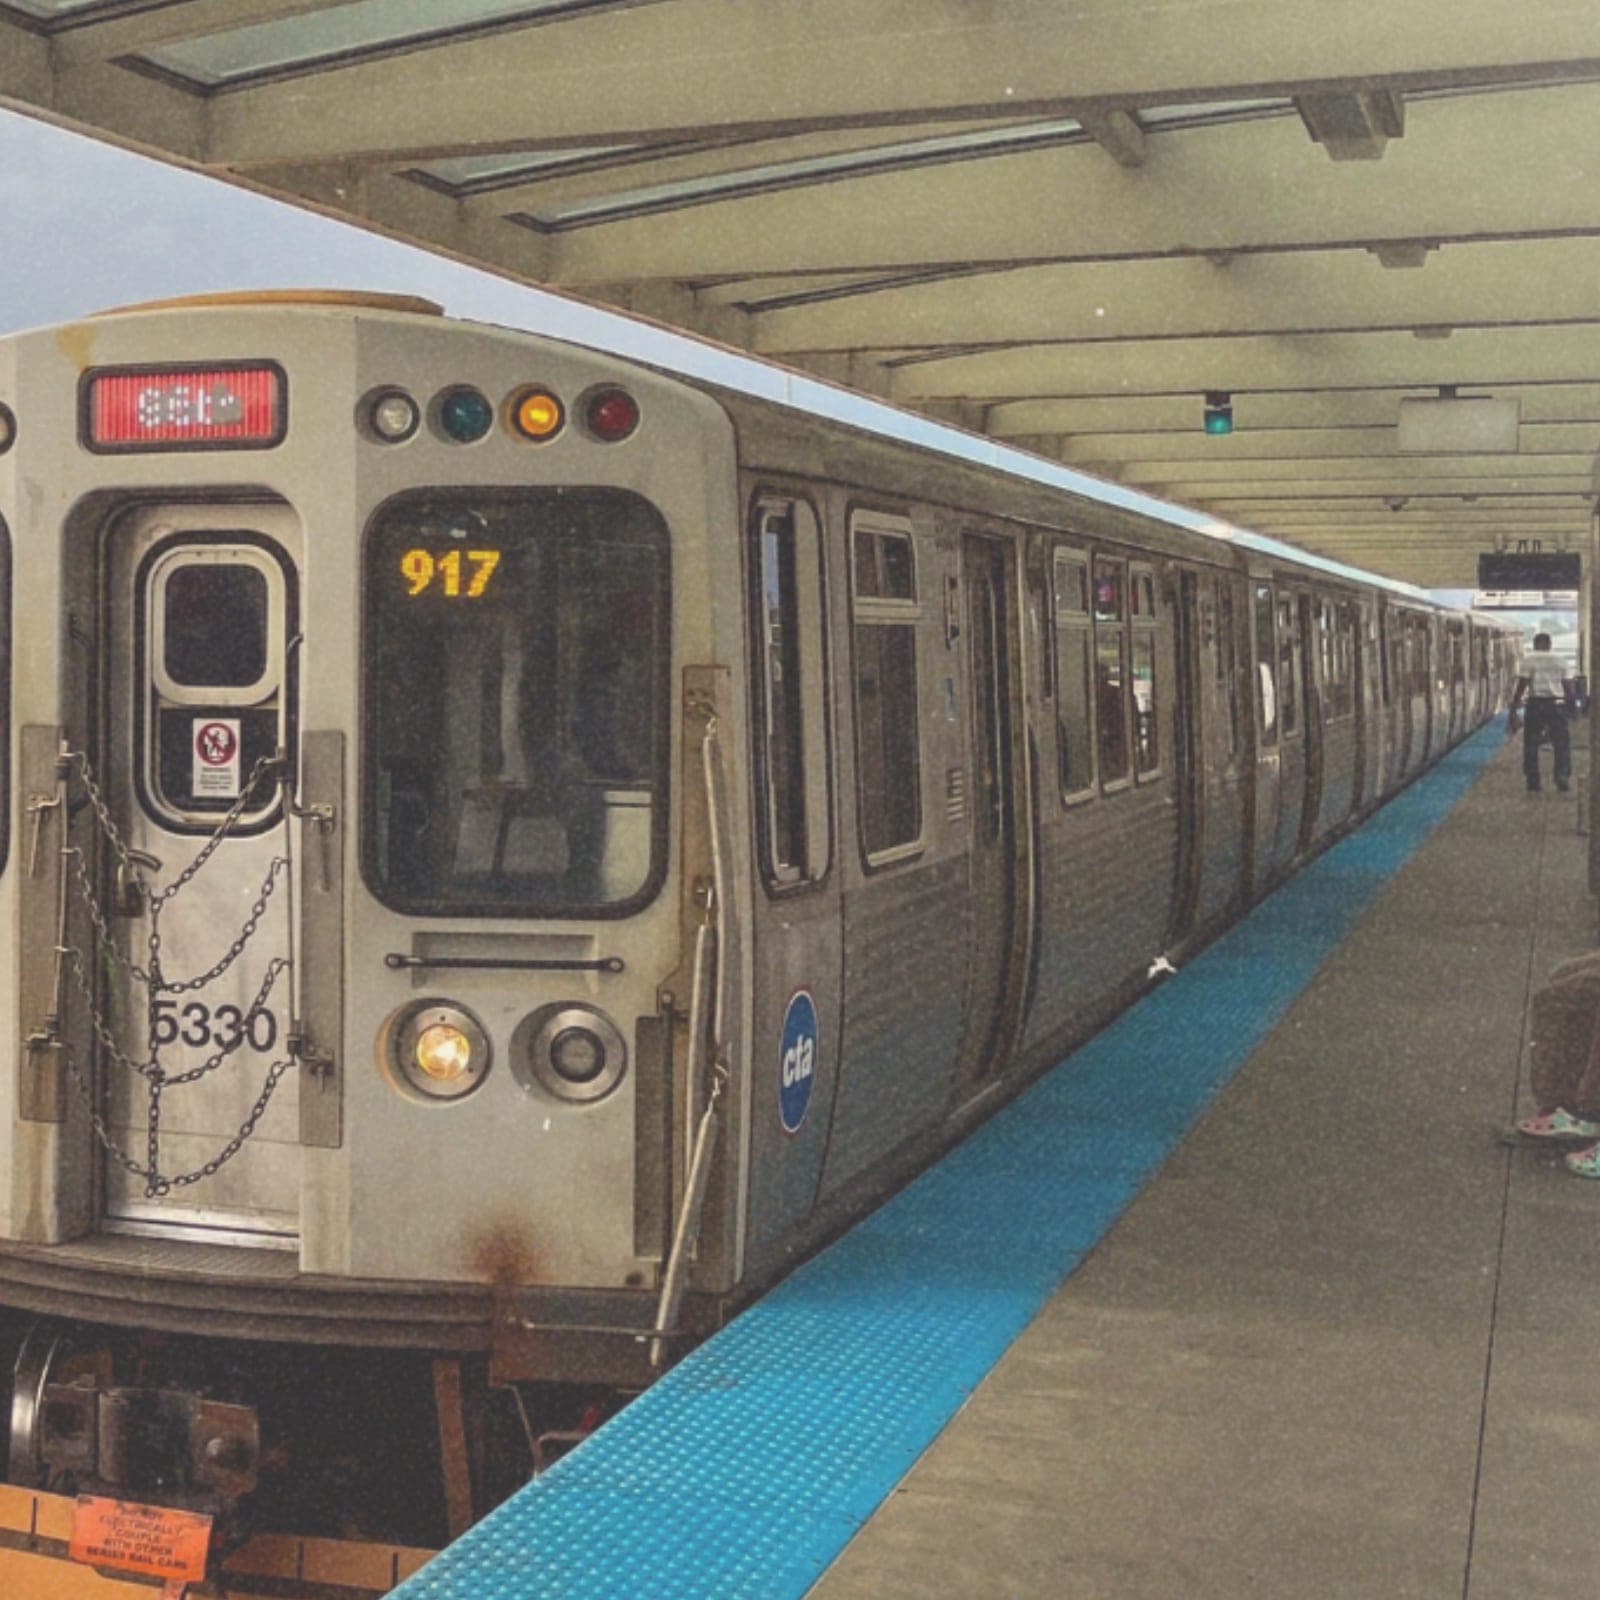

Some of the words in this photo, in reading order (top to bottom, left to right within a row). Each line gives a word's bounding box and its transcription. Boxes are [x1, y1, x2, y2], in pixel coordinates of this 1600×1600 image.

[401, 549, 500, 597] 917
[151, 1001, 276, 1052] 5330
[782, 1034, 813, 1088] cta
